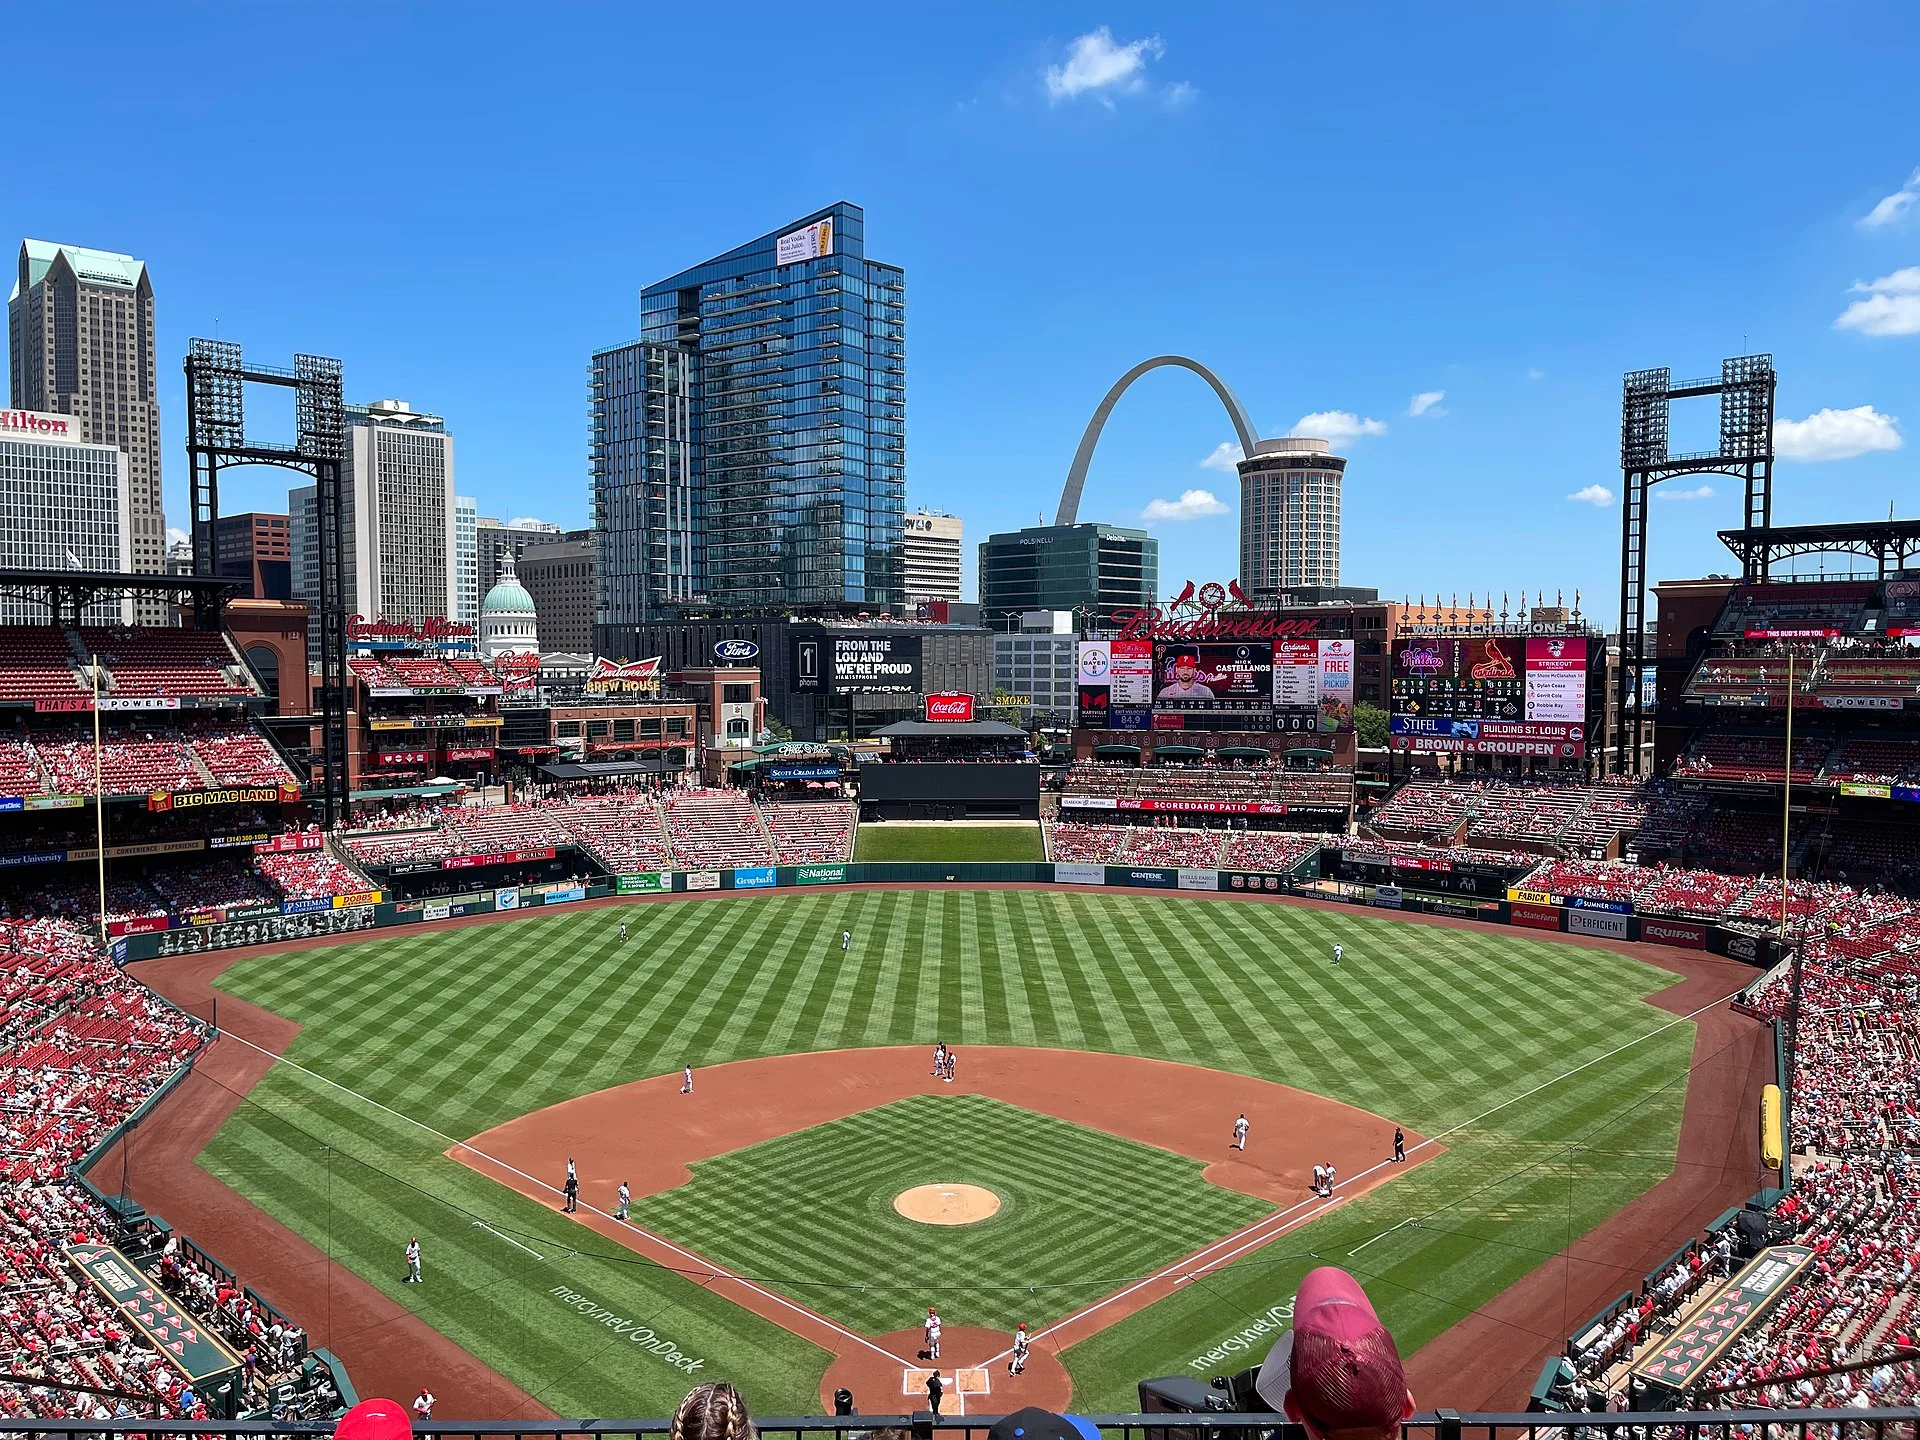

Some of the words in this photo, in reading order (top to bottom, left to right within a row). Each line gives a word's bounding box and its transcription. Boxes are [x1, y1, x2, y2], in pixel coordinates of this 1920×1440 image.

[0, 412, 68, 433] Hilton
[1020, 537, 1054, 545] POLSINELLI
[347, 614, 415, 640] Cardinals
[414, 615, 474, 641] Nation
[1111, 607, 1320, 640] Budweiser
[1412, 624, 1466, 635] WORLD
[1470, 622, 1567, 634] CHAMPIONS
[404, 642, 439, 650] ROOFTOP
[723, 642, 752, 656] Ford
[836, 640, 868, 650] FROM
[870, 640, 891, 650] THE
[1281, 642, 1310, 652] Cardinals
[836, 652, 858, 662] LOU
[860, 652, 884, 662] AND
[1400, 650, 1444, 667] Phillies
[836, 664, 872, 674] WE'RE
[874, 664, 912, 674] PROUD
[1216, 664, 1271, 672] CASTELLANOS
[1324, 660, 1349, 672] FREE
[586, 680, 618, 692] BREW
[622, 680, 660, 692] HOUSE
[799, 678, 818, 688] phorm
[1324, 680, 1350, 688] PICKUP
[38, 700, 77, 710] THAT'S
[81, 700, 88, 710] A
[110, 700, 164, 708] POWER
[996, 696, 1031, 706] SMOKE
[1836, 698, 1886, 706] POWER
[931, 702, 968, 714] Coca-Cola
[1121, 716, 1140, 724] 84.9
[1276, 719, 1284, 729] 0
[1292, 719, 1300, 729] 0
[1306, 719, 1314, 729] 0
[1403, 718, 1438, 730] STIFEL
[1484, 724, 1524, 734] BUILDING
[1525, 726, 1538, 734] ST.
[1540, 727, 1566, 736] LOUIS
[1156, 736, 1166, 746] 10
[1172, 737, 1184, 746] 14
[1206, 737, 1220, 747] 20
[1266, 738, 1280, 748] 42
[1416, 738, 1464, 750] BROWN
[1467, 743, 1474, 751] &
[1478, 741, 1554, 754] CROUPPEN
[174, 794, 202, 808] BIG
[204, 791, 238, 804] MAC
[240, 789, 277, 802] LAND
[1120, 800, 1142, 808] Coca-Cola
[1154, 802, 1216, 810] SCOREBOARD
[1260, 804, 1283, 812] Coca-Cola
[164, 842, 200, 850] EXPERIENCE
[24, 853, 62, 863] University
[522, 850, 546, 859] PURINA
[1356, 852, 1388, 860] Schnucks
[808, 868, 844, 878] National
[1131, 872, 1162, 880] CENTENE
[1382, 888, 1394, 896] Ford
[295, 898, 330, 908] SITEMAN
[343, 894, 372, 903] DOBBS
[1324, 894, 1349, 902] STADIUM
[1518, 892, 1546, 902] FABICK
[1550, 896, 1564, 904] CAT
[238, 908, 262, 917] Central
[262, 906, 280, 914] Bank
[190, 912, 212, 922] planet
[1571, 914, 1624, 932] PERFICIENT
[1646, 925, 1699, 940] EQUIFAX
[548, 1285, 704, 1374] mercy.net/OnDeck
